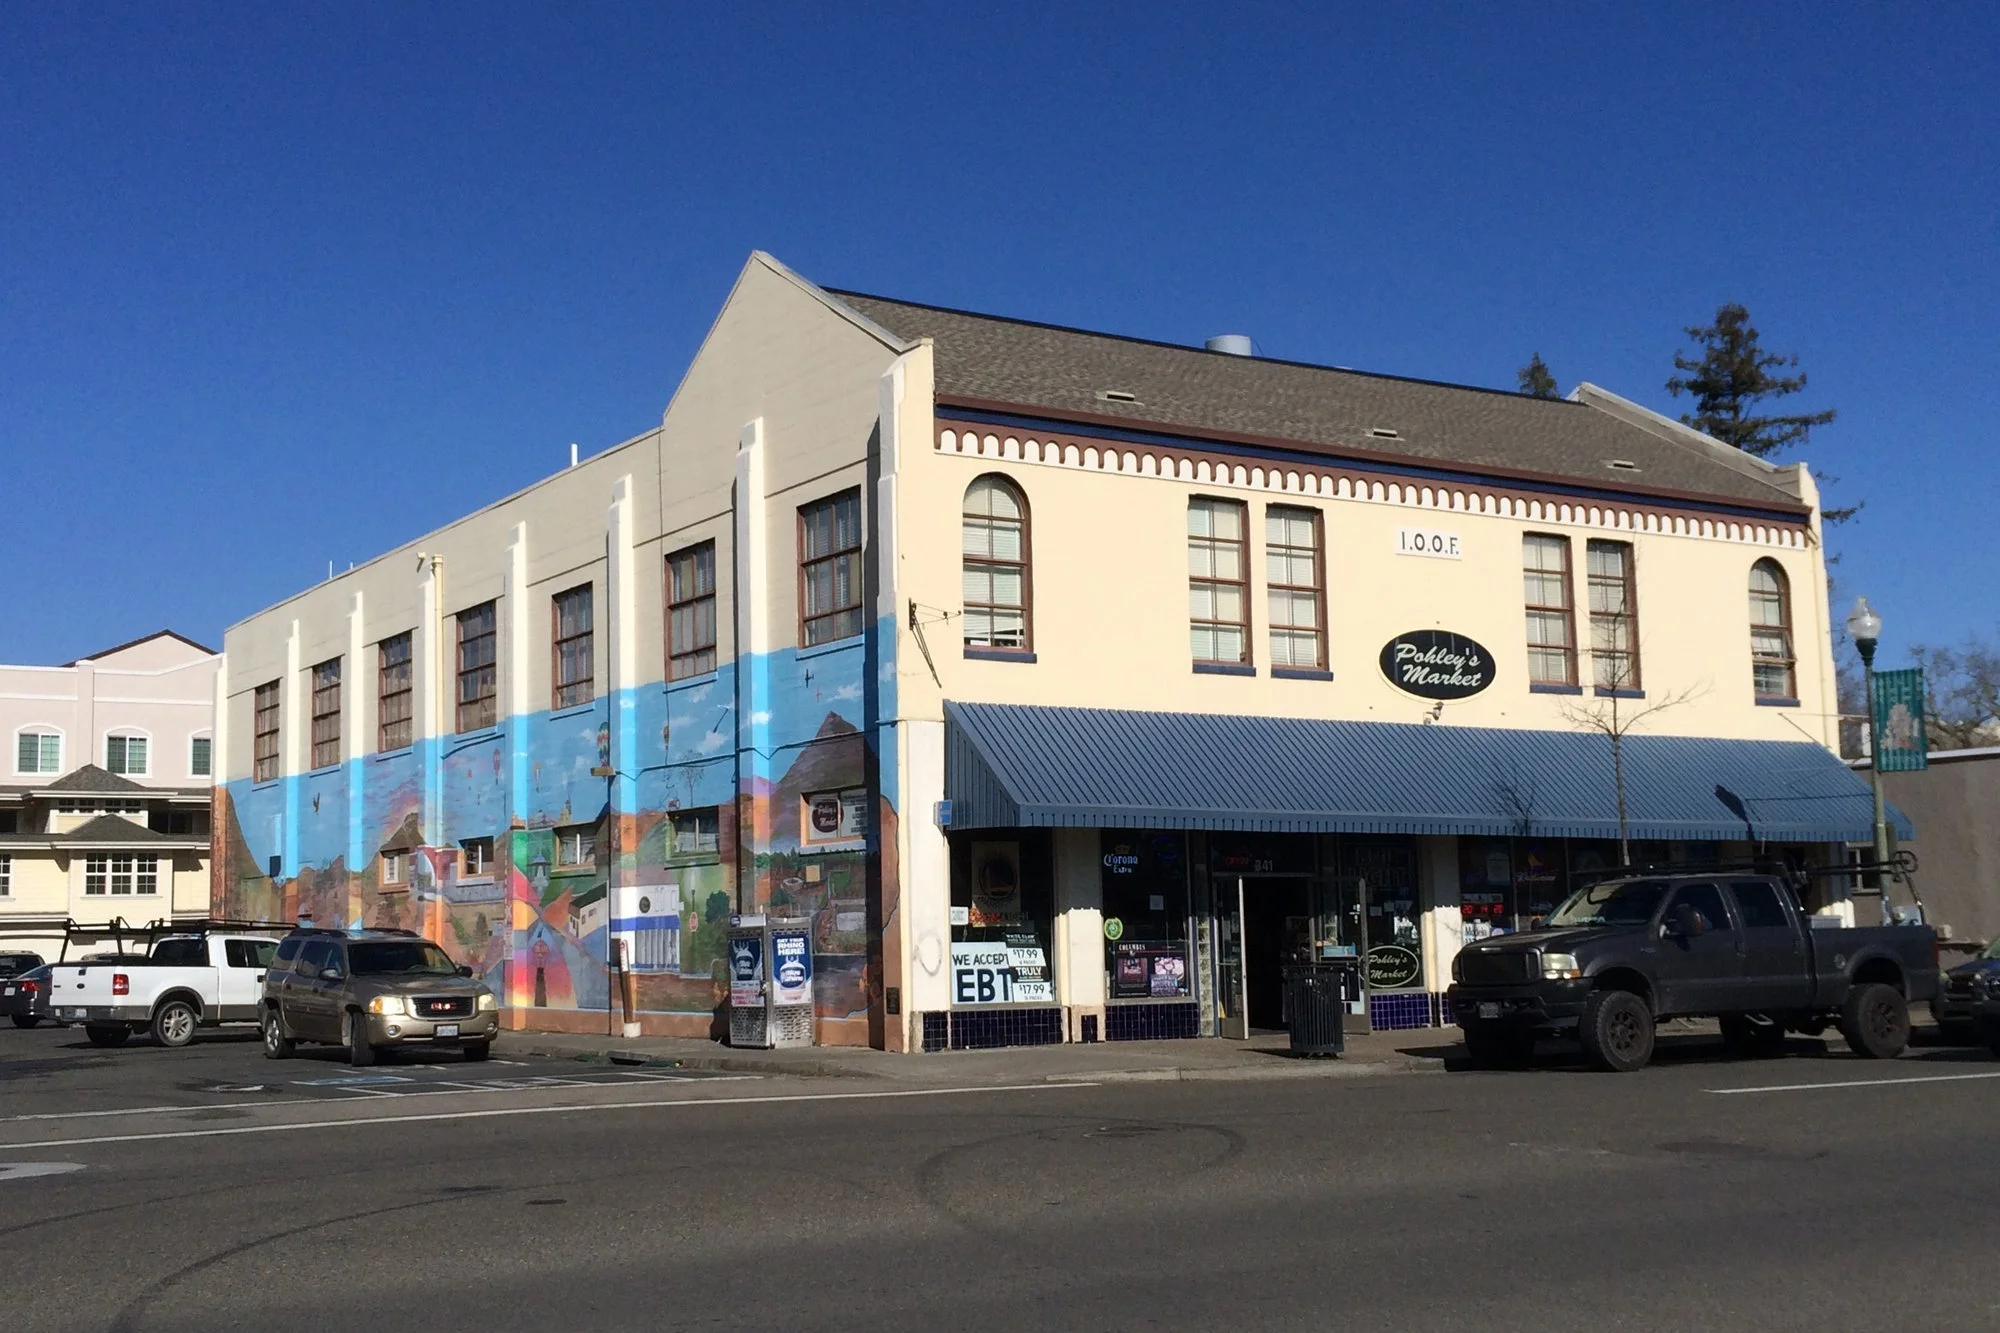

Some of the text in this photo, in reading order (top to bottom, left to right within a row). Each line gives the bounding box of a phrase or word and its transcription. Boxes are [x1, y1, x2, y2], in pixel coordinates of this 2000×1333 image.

[1401, 531, 1459, 555] I.O.O.F.
[1396, 643, 1480, 669] Pohley's
[1402, 664, 1482, 686] Market
[1103, 853, 1138, 867] Corona
[1113, 864, 1132, 873] Extra
[778, 948, 805, 956] HERE!
[952, 953, 1009, 966] WE ACCEPT
[1366, 953, 1408, 966] Pohley's
[1016, 966, 1042, 976] TRULY
[1370, 969, 1408, 980] Market
[956, 968, 1012, 1003] EBT
